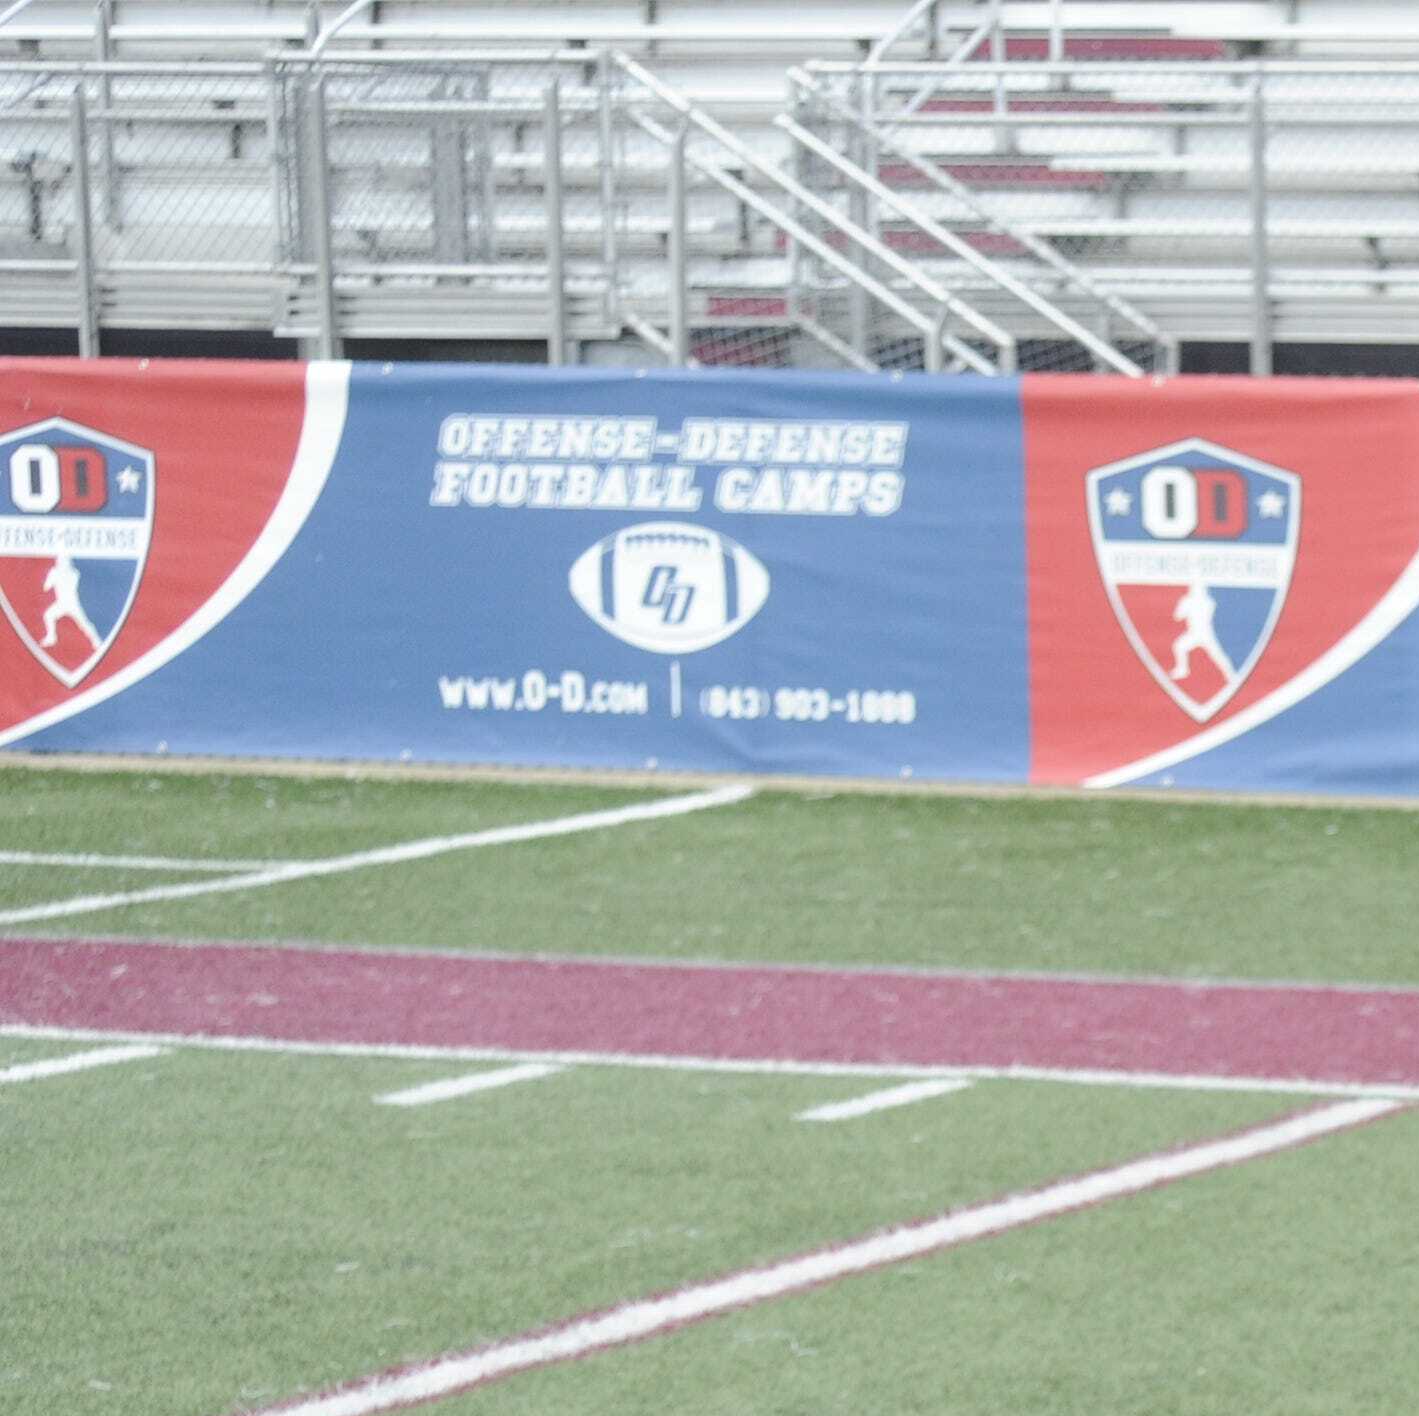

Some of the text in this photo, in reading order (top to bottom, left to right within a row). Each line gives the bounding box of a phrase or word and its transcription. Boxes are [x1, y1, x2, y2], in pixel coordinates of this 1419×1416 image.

[437, 412, 910, 468] OFFENSE-DEFENSE
[9, 443, 108, 513] OD
[429, 459, 906, 517] FOOTBALL CAMPS
[1141, 466, 1249, 540] OD
